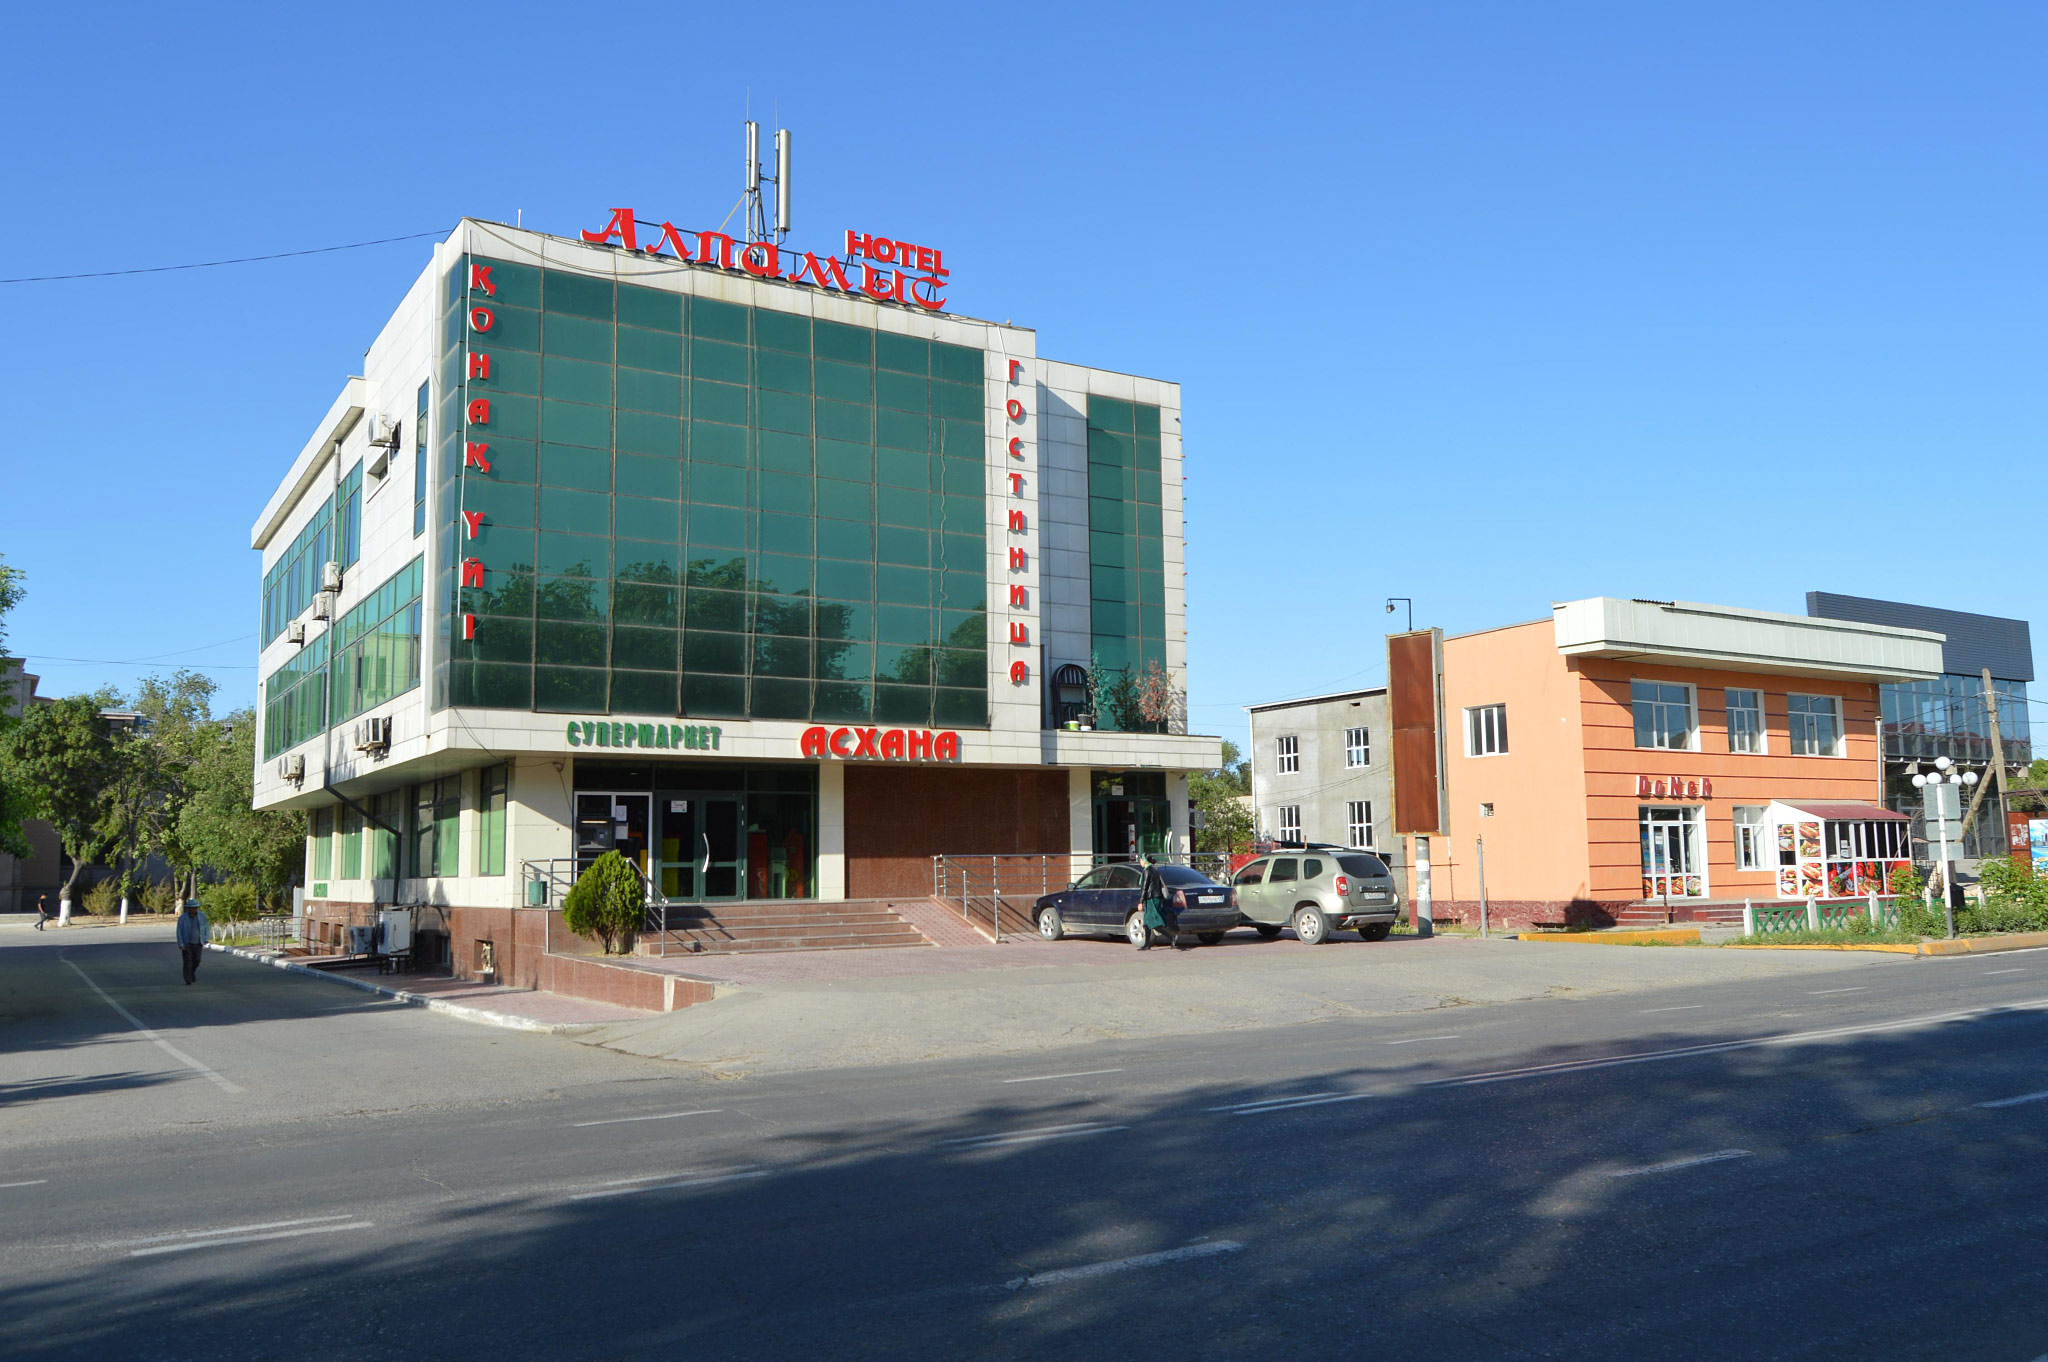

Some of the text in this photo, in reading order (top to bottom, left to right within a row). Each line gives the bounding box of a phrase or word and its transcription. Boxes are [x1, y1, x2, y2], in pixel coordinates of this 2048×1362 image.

[580, 208, 949, 310] Алпамыс
[845, 229, 950, 277] HOTEL
[1006, 359, 1026, 684] ГОСТИНИЦА
[567, 721, 721, 750] СУПЕРМАРКЕТ
[800, 726, 958, 762] АСХАНА
